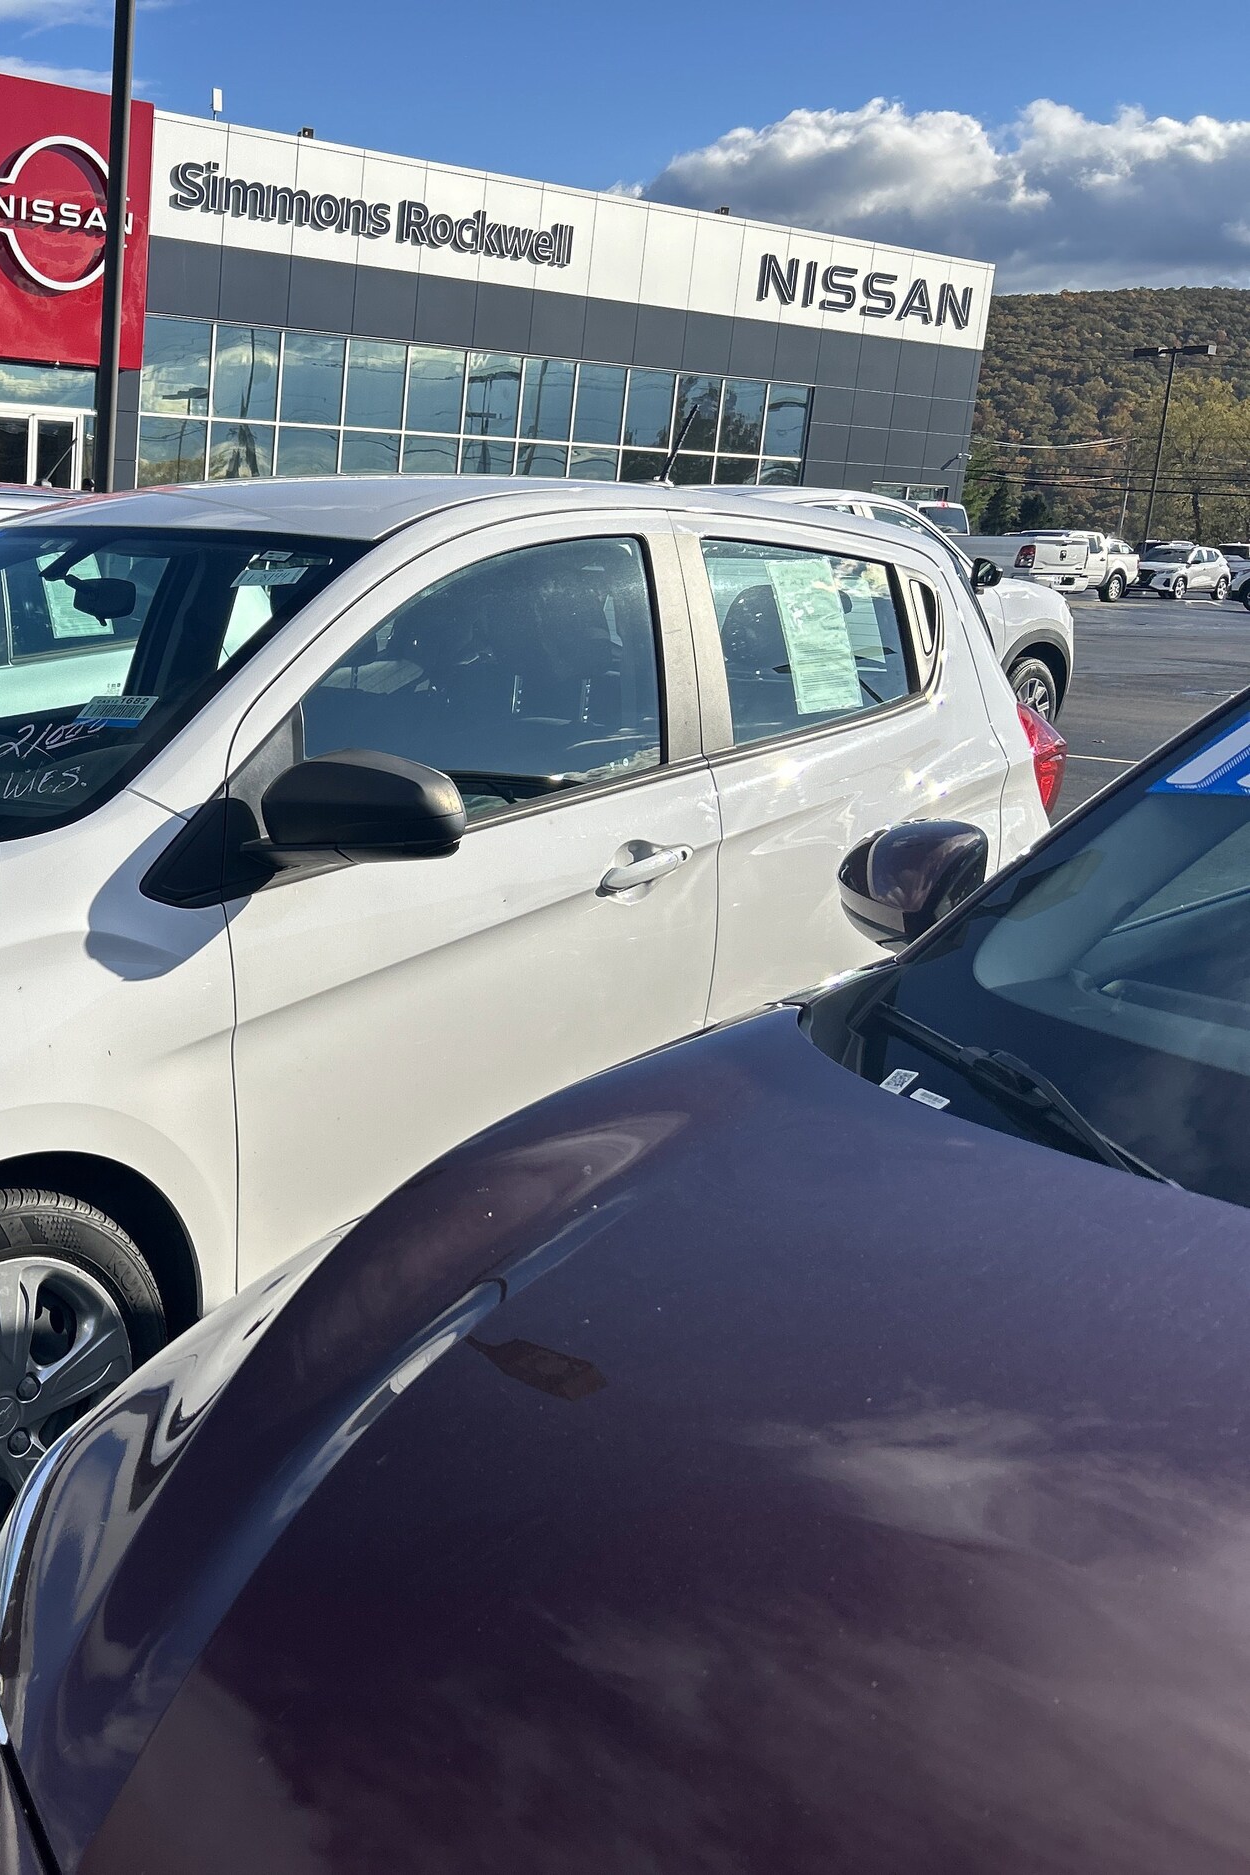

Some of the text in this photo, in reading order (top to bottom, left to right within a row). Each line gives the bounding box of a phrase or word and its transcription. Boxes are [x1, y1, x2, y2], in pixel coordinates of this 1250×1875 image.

[170, 161, 574, 268] Simmons Rockwell
[756, 253, 974, 330] NISSAN
